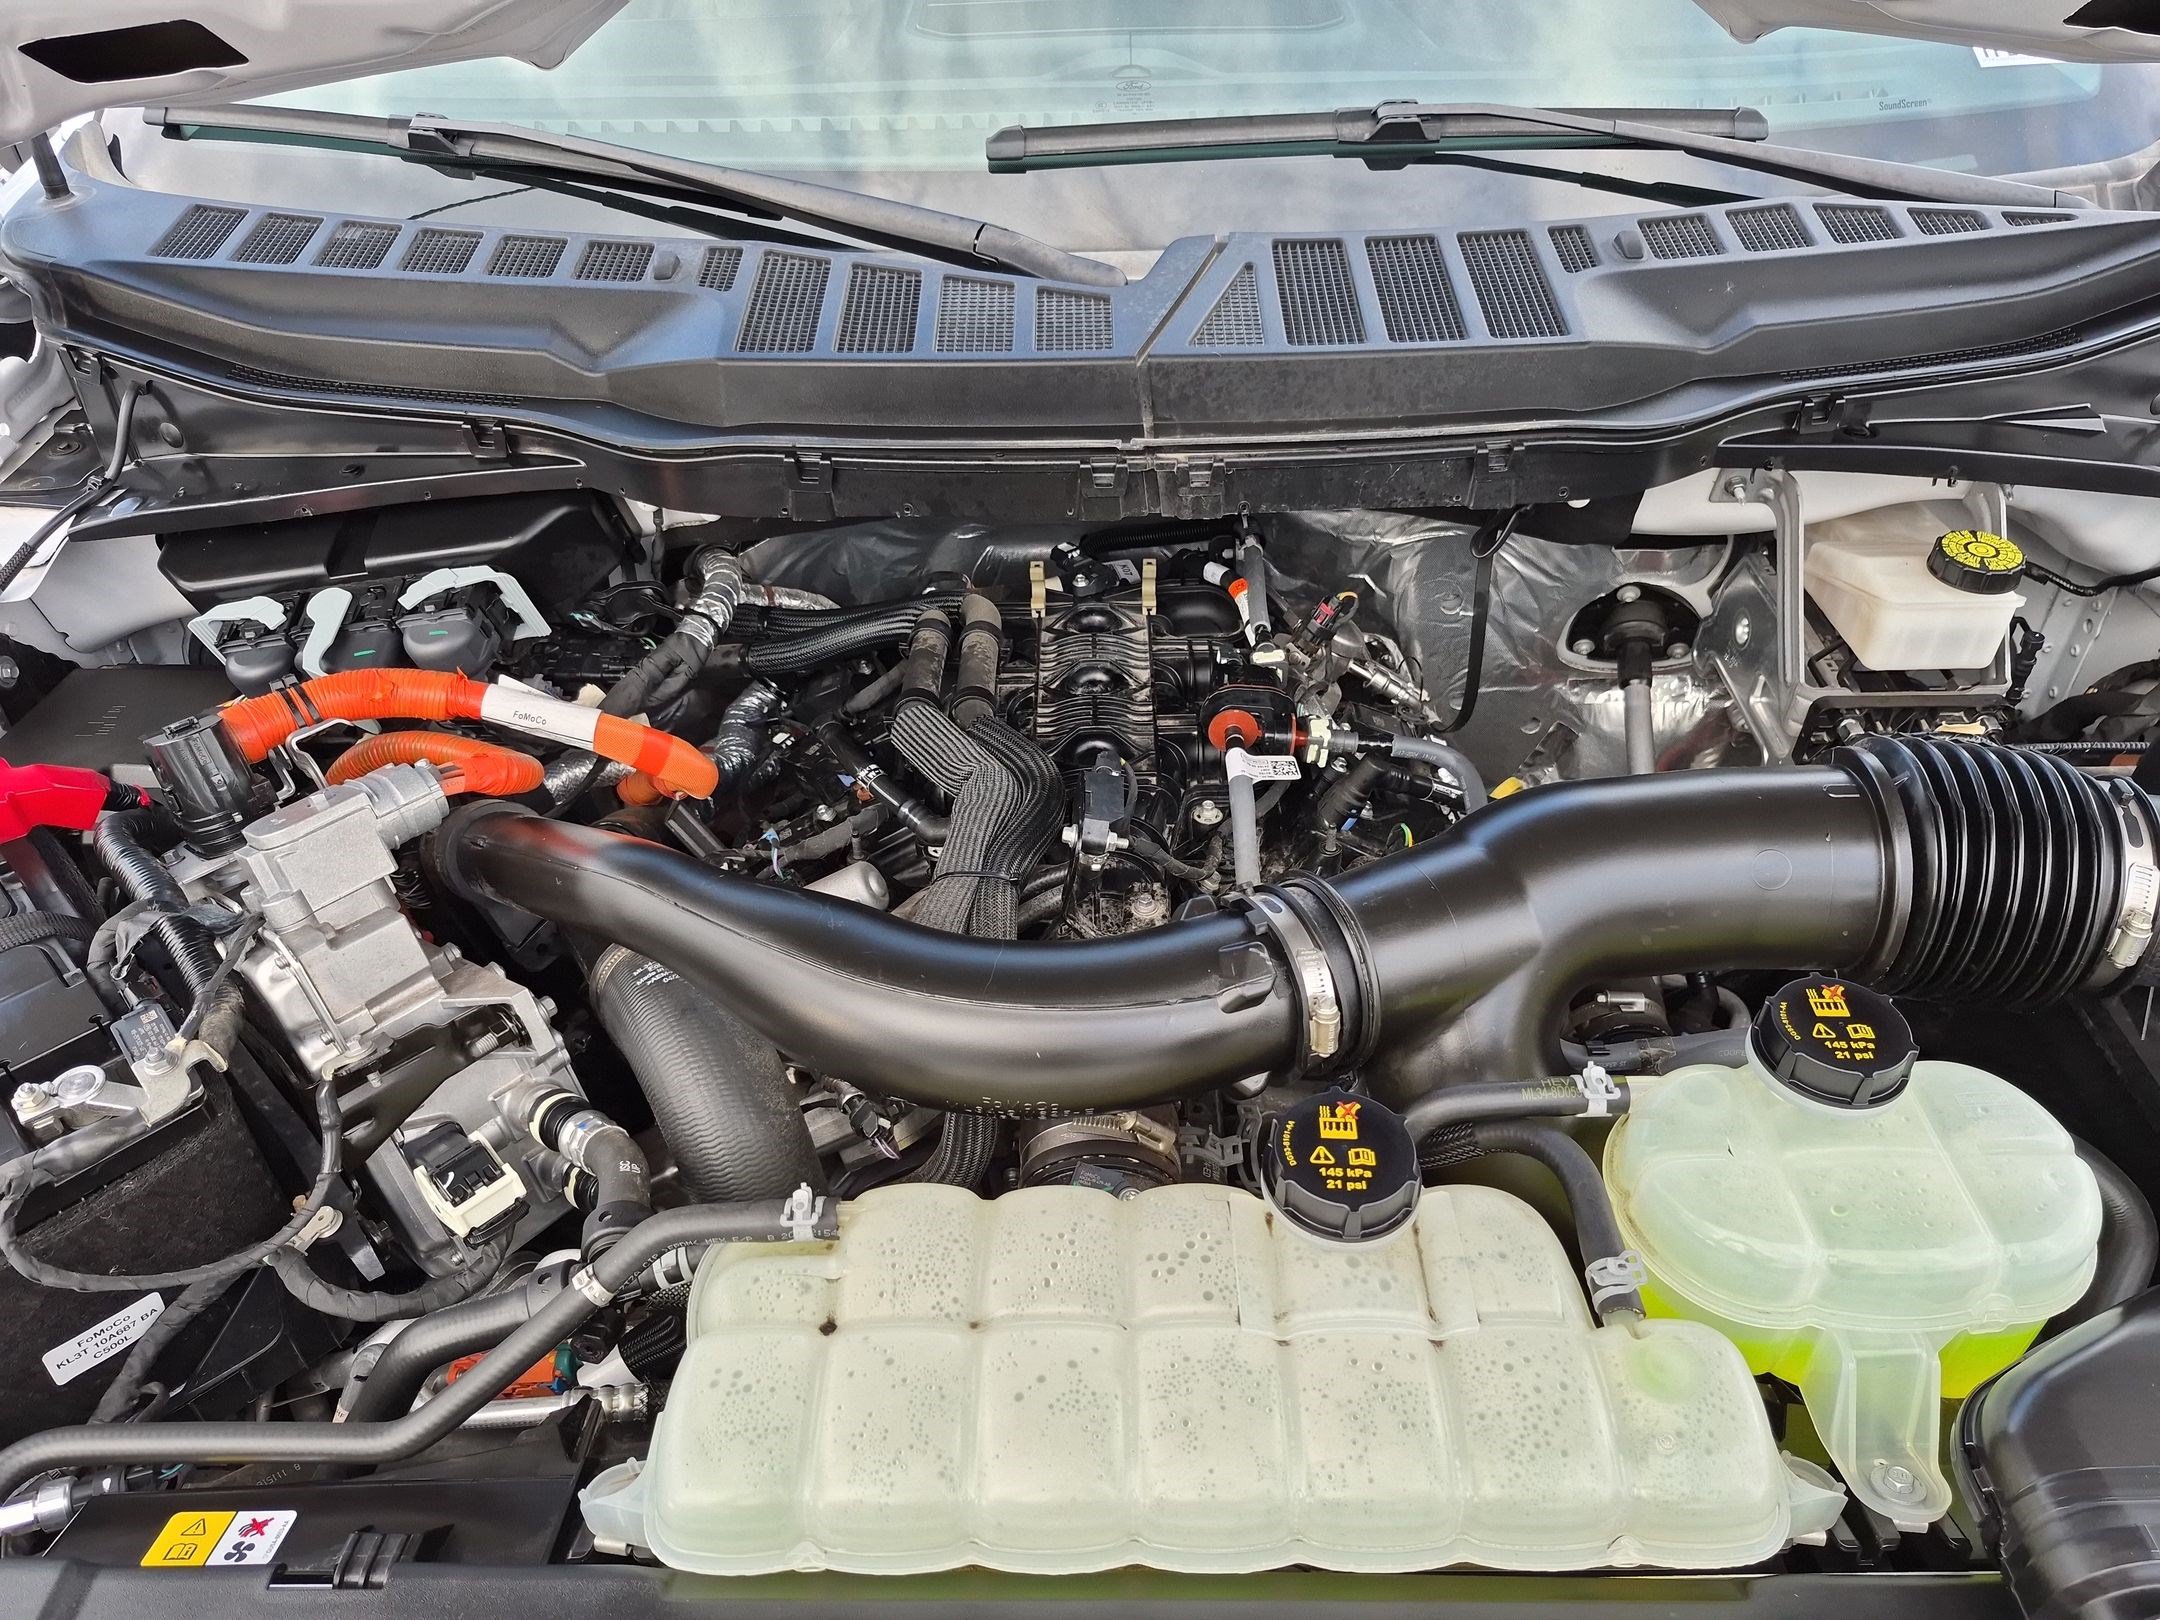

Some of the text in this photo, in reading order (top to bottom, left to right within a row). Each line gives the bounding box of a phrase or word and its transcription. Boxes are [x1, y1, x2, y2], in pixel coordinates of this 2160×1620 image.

[512, 710, 547, 725] FoMoCo
[1824, 1041, 1876, 1049] 145 kPa
[1834, 1051, 1874, 1061] 21 psi
[1541, 1078, 1569, 1088] HEV
[1319, 1167, 1373, 1178] 145 kPa
[1326, 1179, 1367, 1191] 21 psi
[77, 1315, 131, 1347] FoMoCo
[56, 1308, 158, 1369] KL3T 10A687 BA
[93, 1336, 132, 1359] C500L
